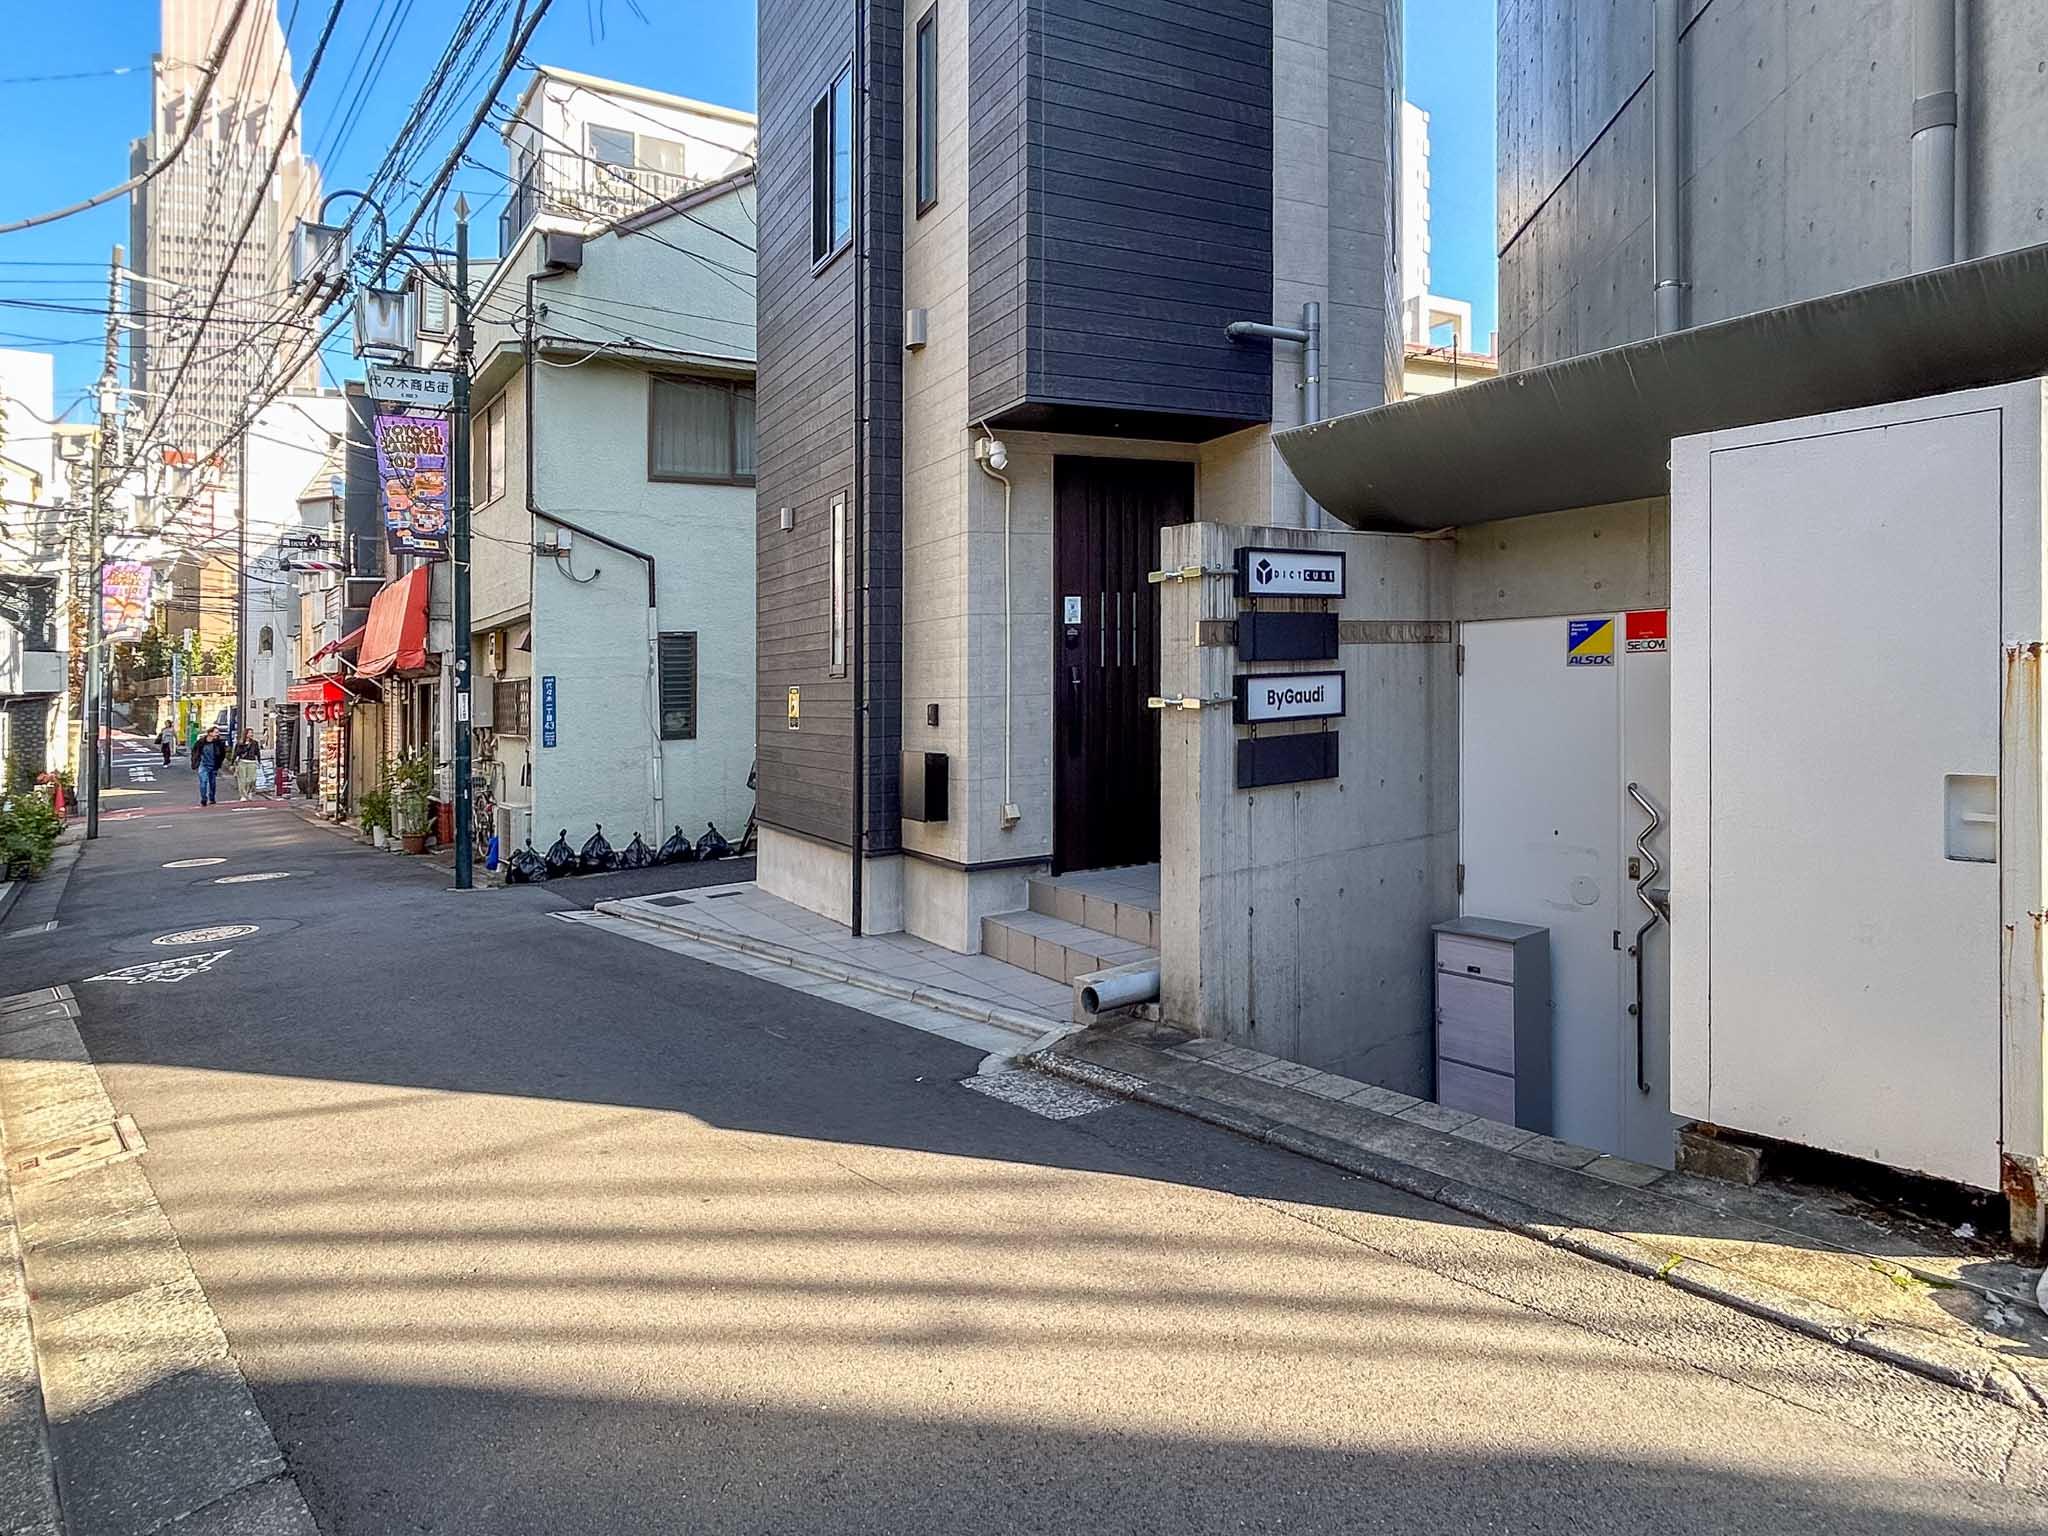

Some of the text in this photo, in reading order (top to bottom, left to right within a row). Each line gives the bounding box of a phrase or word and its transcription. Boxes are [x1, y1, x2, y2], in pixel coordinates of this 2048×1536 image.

[369, 375, 449, 394] 代々木商店街
[383, 425, 438, 438] YOYOGI
[380, 435, 443, 447] HALLOWEEN
[382, 443, 444, 455] CARNIVAL
[1627, 640, 1666, 650] SECOM
[1569, 655, 1611, 665] ALSOK
[1267, 685, 1324, 711] ByGaudi
